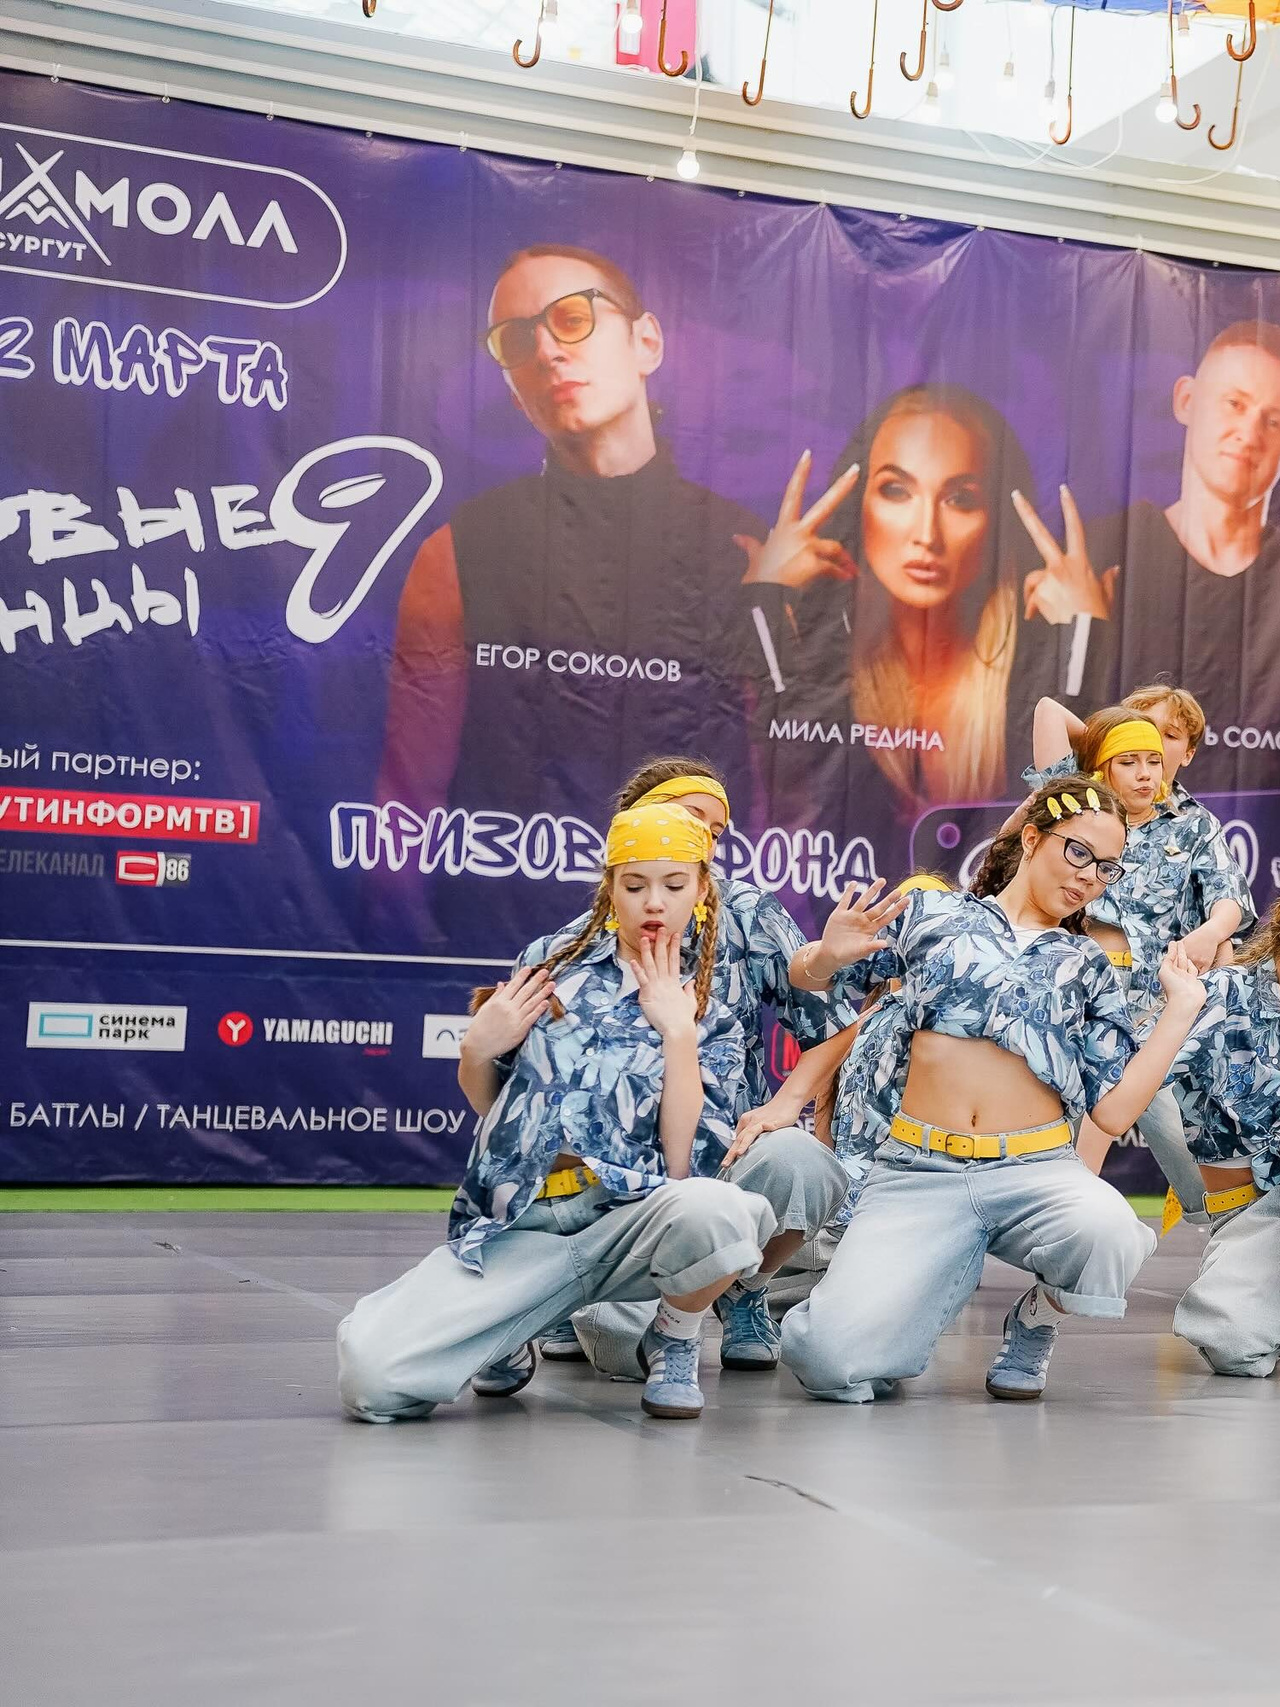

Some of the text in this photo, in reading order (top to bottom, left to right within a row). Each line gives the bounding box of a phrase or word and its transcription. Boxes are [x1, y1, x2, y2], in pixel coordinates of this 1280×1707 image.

[75, 169, 299, 254] МОЛЛ
[53, 316, 289, 412] МАРТА
[476, 643, 682, 683] ЕГОР СОКОЛОВ
[769, 719, 945, 751] МИЛА РЕДИНА
[52, 752, 201, 785] партнер:
[330, 800, 608, 883] ПРИЗОВ
[99, 1028, 149, 1043] парк
[100, 1015, 175, 1027] синема
[263, 1018, 393, 1045] YAMAGUCHI
[10, 1102, 125, 1128] БАТТЛЫ
[157, 1104, 387, 1133] ТАНЦЕВАЛЬНОЕ
[396, 1108, 466, 1134] ШОУ
